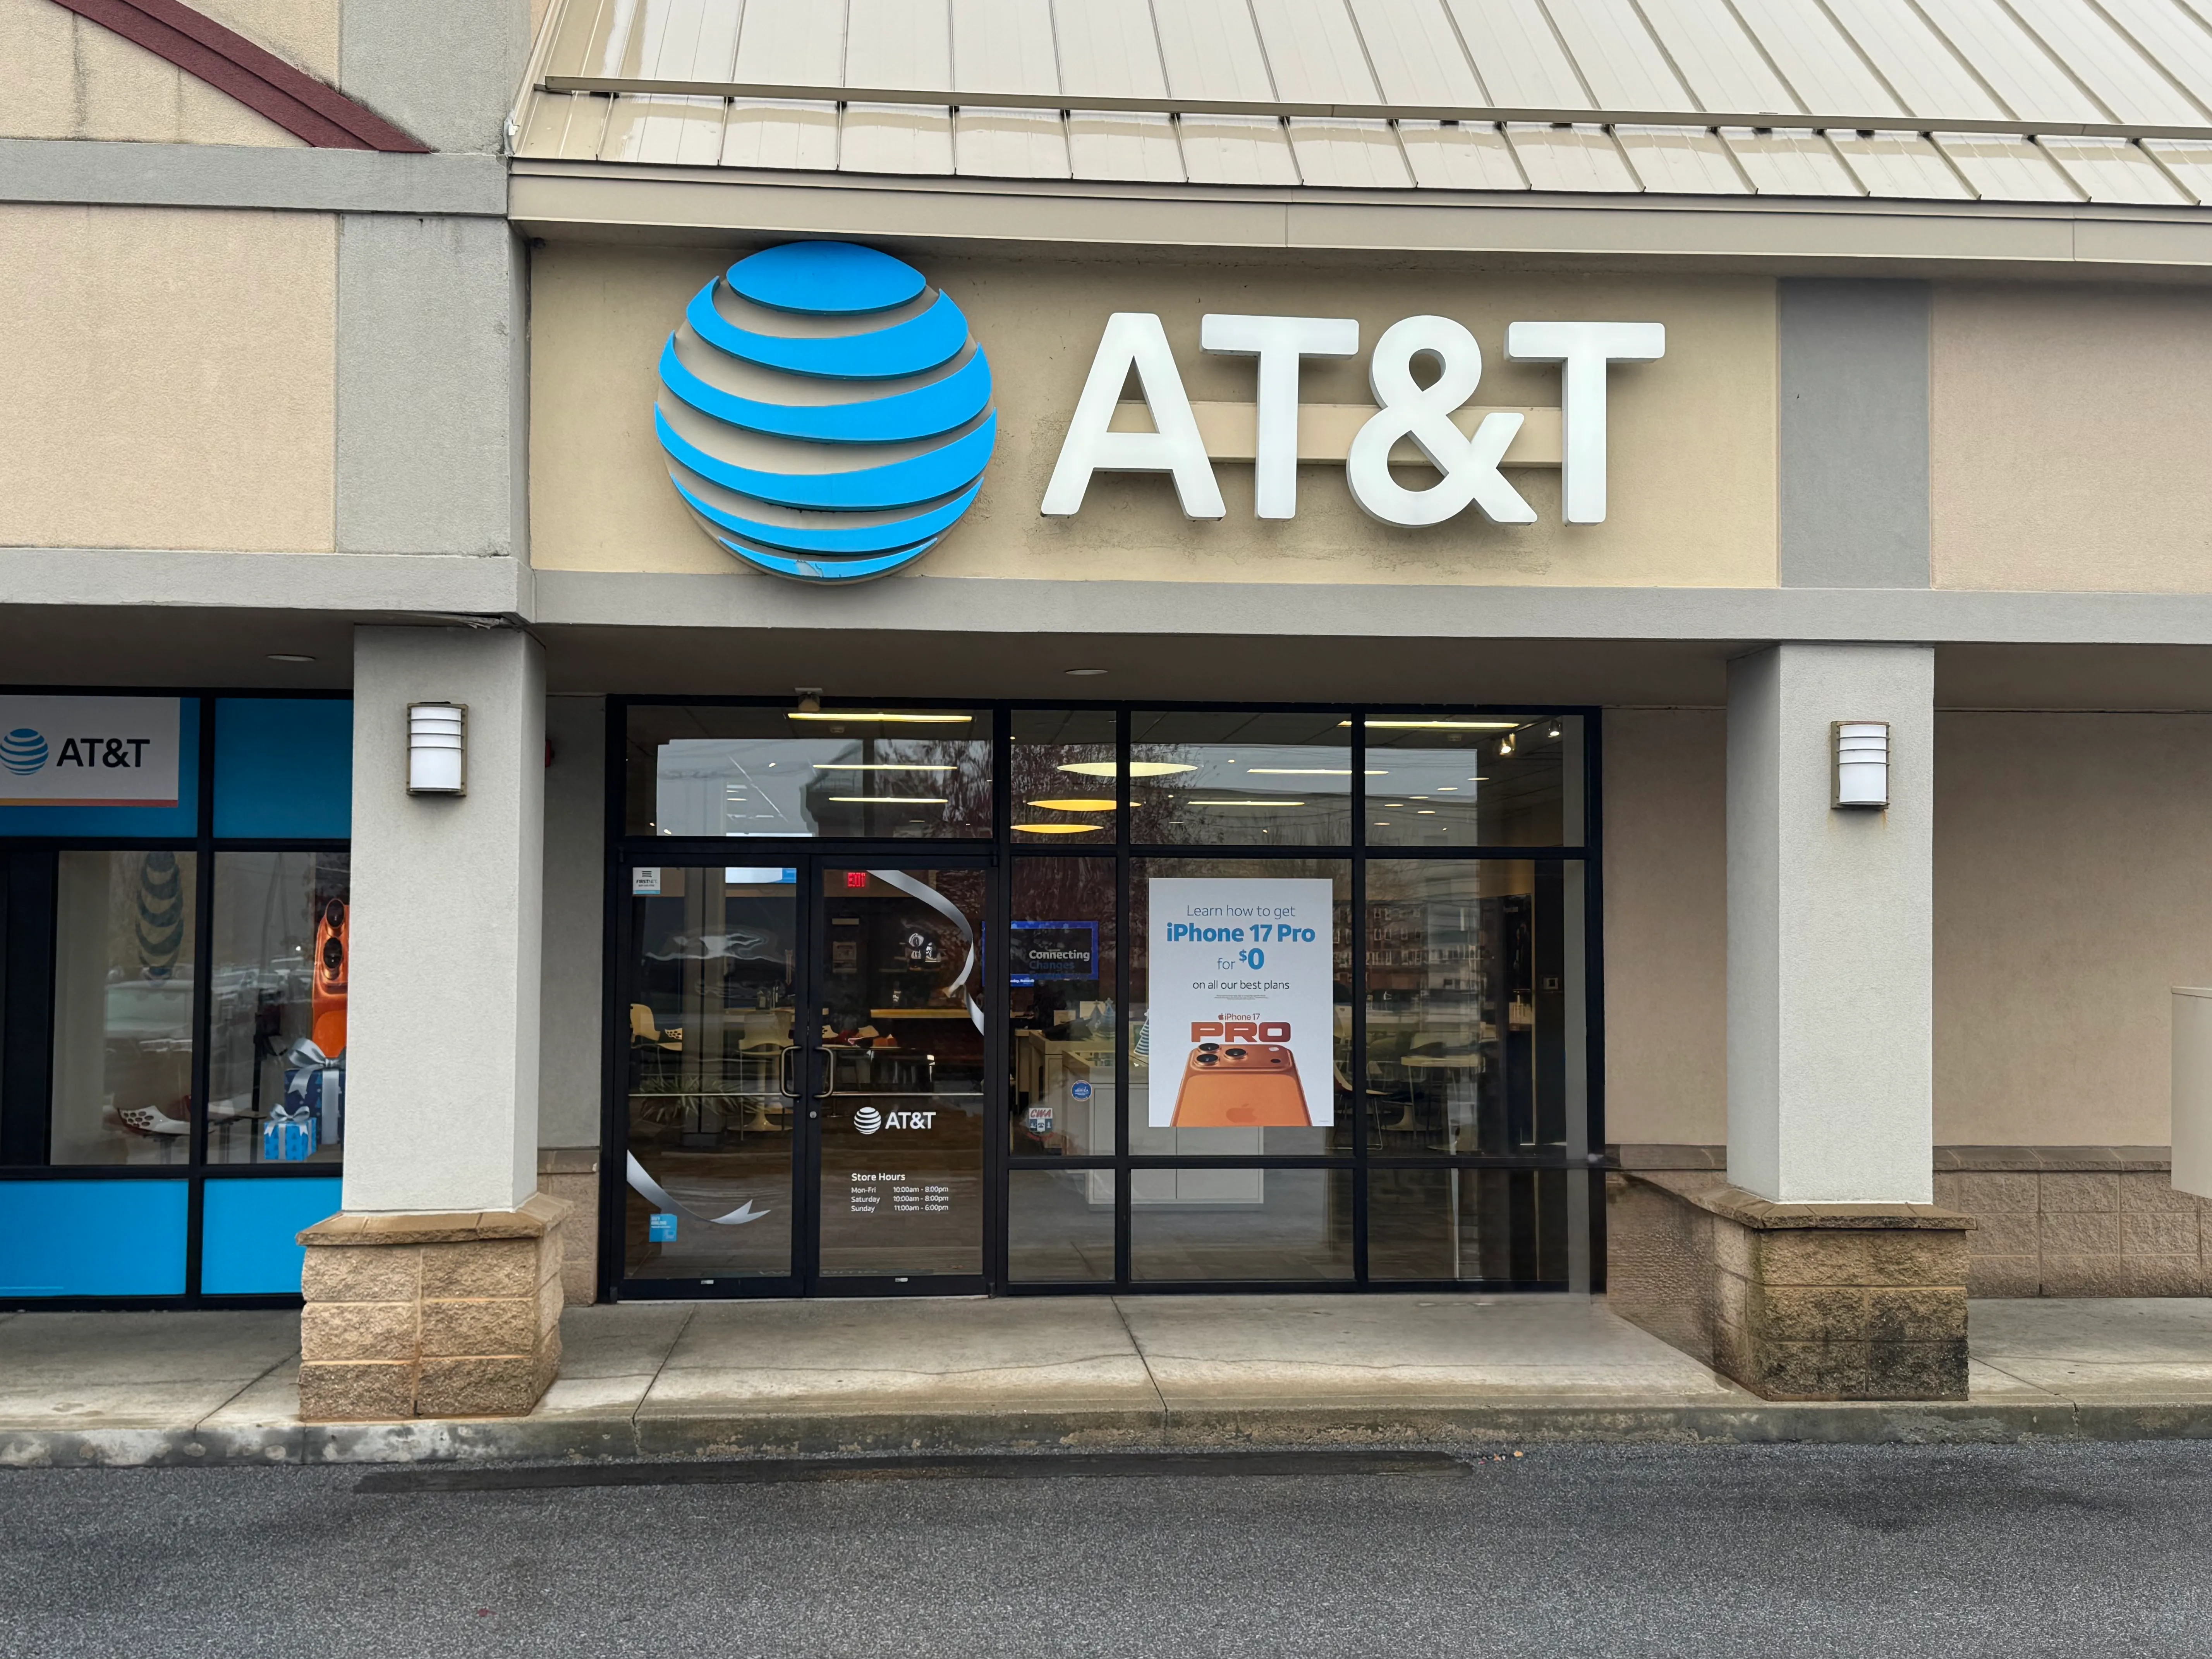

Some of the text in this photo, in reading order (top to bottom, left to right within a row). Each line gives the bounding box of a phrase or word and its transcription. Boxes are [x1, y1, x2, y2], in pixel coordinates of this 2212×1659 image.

[1041, 313, 1665, 527] AT&T
[57, 738, 150, 768] AT&T
[1187, 905, 1295, 920] Learn how to get
[1167, 922, 1316, 943] iPhone 17 Pro
[1029, 950, 1090, 961] Connecting
[1217, 948, 1265, 970] for $0
[1029, 961, 1074, 970] Changes
[1208, 980, 1218, 989] all
[1240, 980, 1261, 989] best
[1264, 980, 1290, 991] plans
[1191, 1022, 1291, 1042] PRO
[1030, 1109, 1052, 1118] CWA
[885, 1111, 936, 1130] AT&T
[852, 1173, 906, 1181] Store Hours
[851, 1196, 880, 1204] Saturday
[851, 1205, 875, 1213] Sunday
